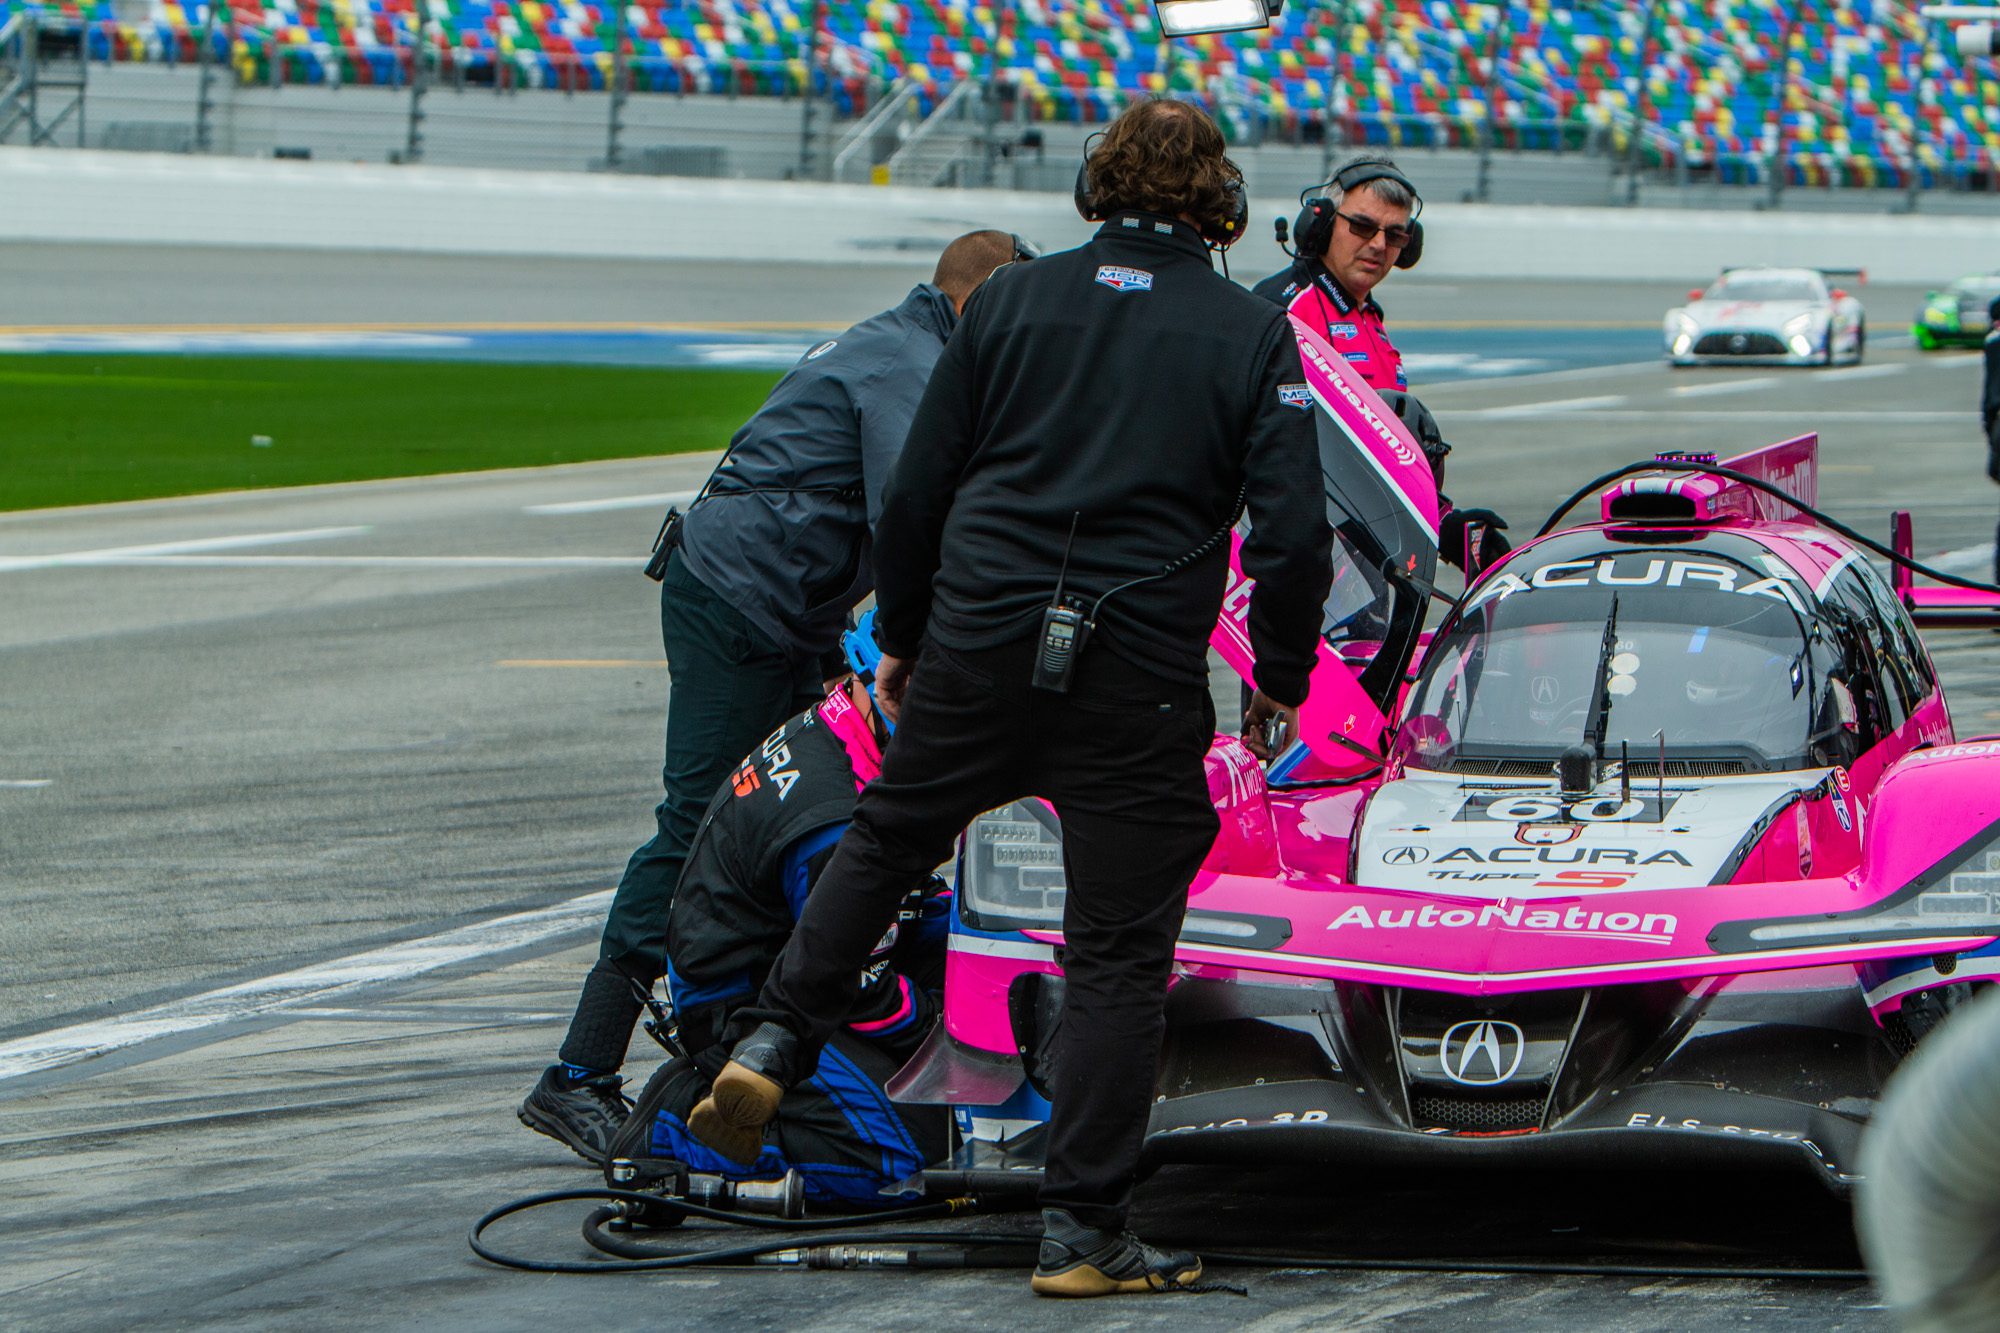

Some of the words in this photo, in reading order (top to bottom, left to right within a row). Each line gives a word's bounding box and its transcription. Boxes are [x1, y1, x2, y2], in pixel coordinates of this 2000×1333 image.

[1099, 271, 1151, 287] MSR
[1319, 273, 1350, 312] AutoNation
[1465, 560, 1808, 616] ACURA
[1486, 797, 1645, 822] 60
[1432, 847, 1694, 867] ACURA
[1532, 871, 1638, 888] S
[1327, 905, 1678, 934] AutoNation
[1626, 1113, 1701, 1130] ELS
